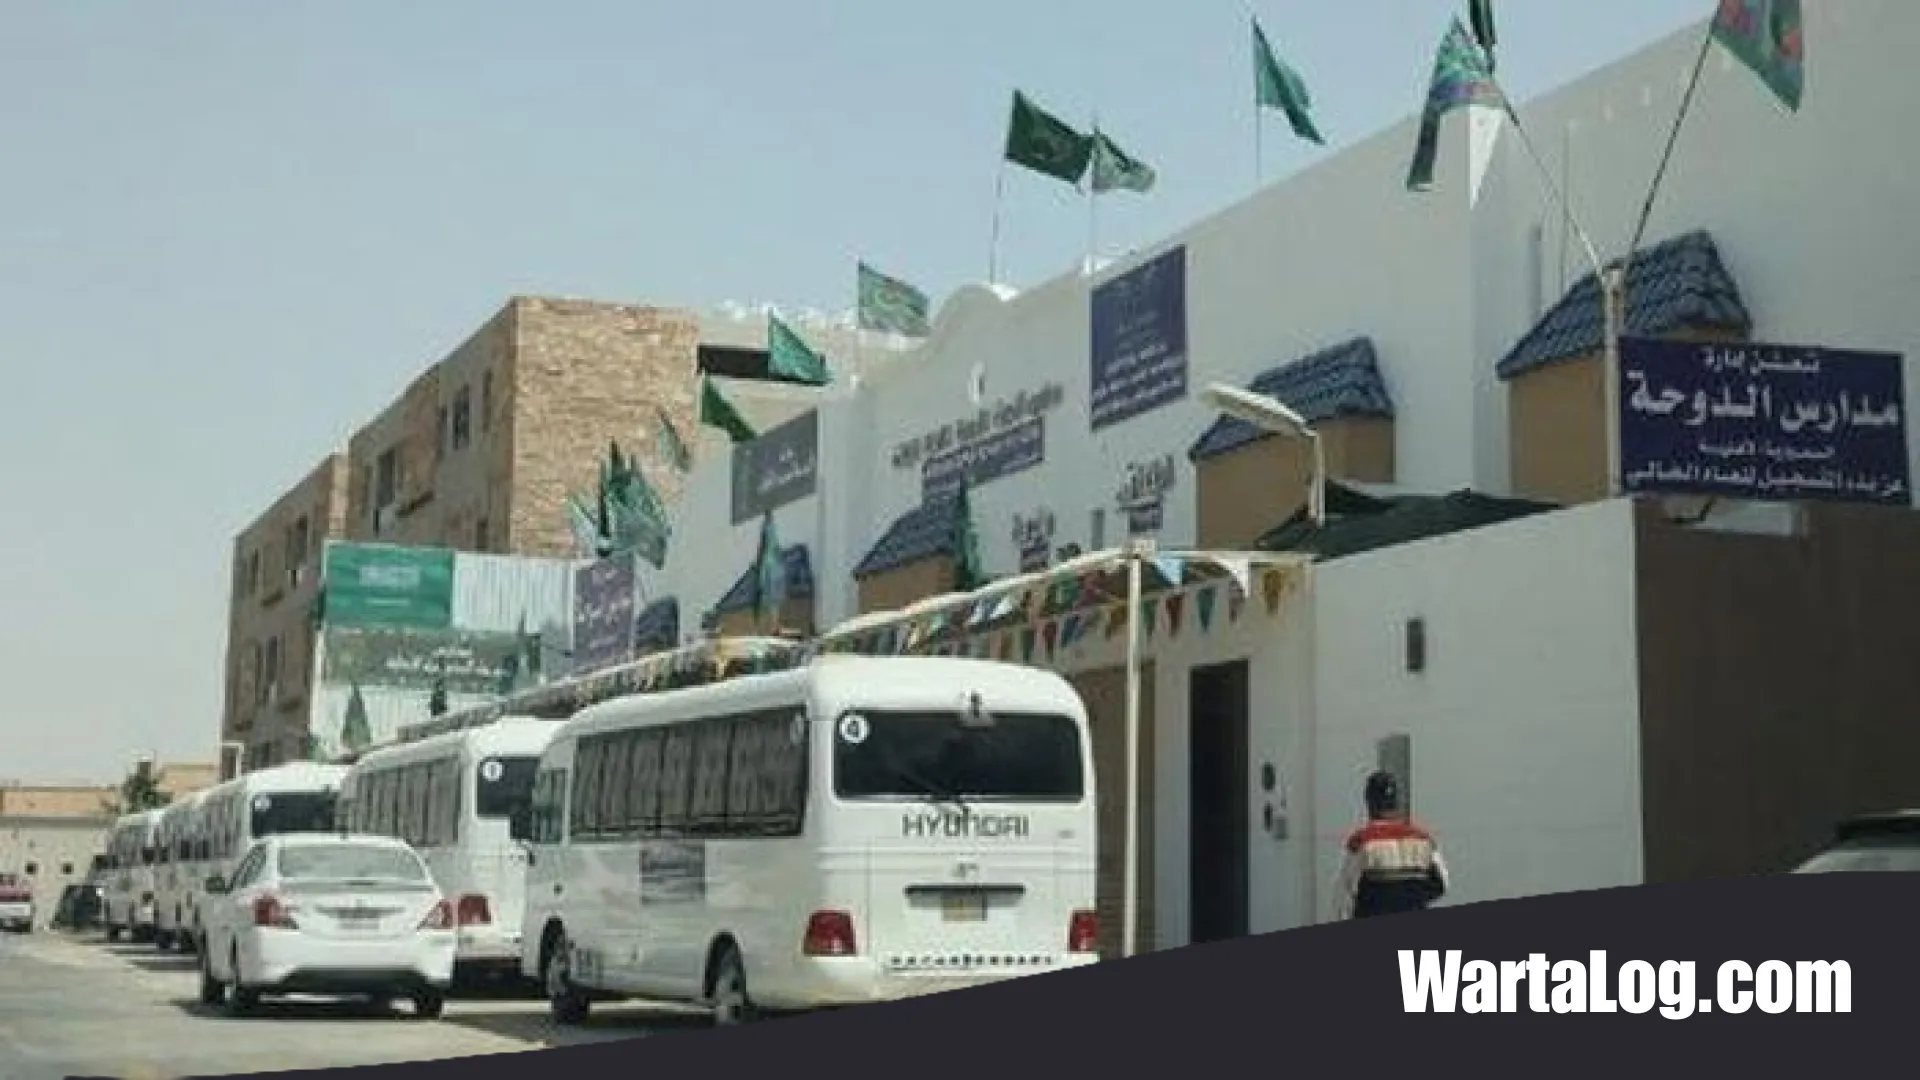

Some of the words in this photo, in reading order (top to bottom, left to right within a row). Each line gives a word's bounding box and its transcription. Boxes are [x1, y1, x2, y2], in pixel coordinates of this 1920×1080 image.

[1626, 370, 1772, 426] الدوحة
[1779, 388, 1899, 432] مدارس
[847, 720, 859, 738] 4
[902, 813, 1030, 837] HYUNDAI
